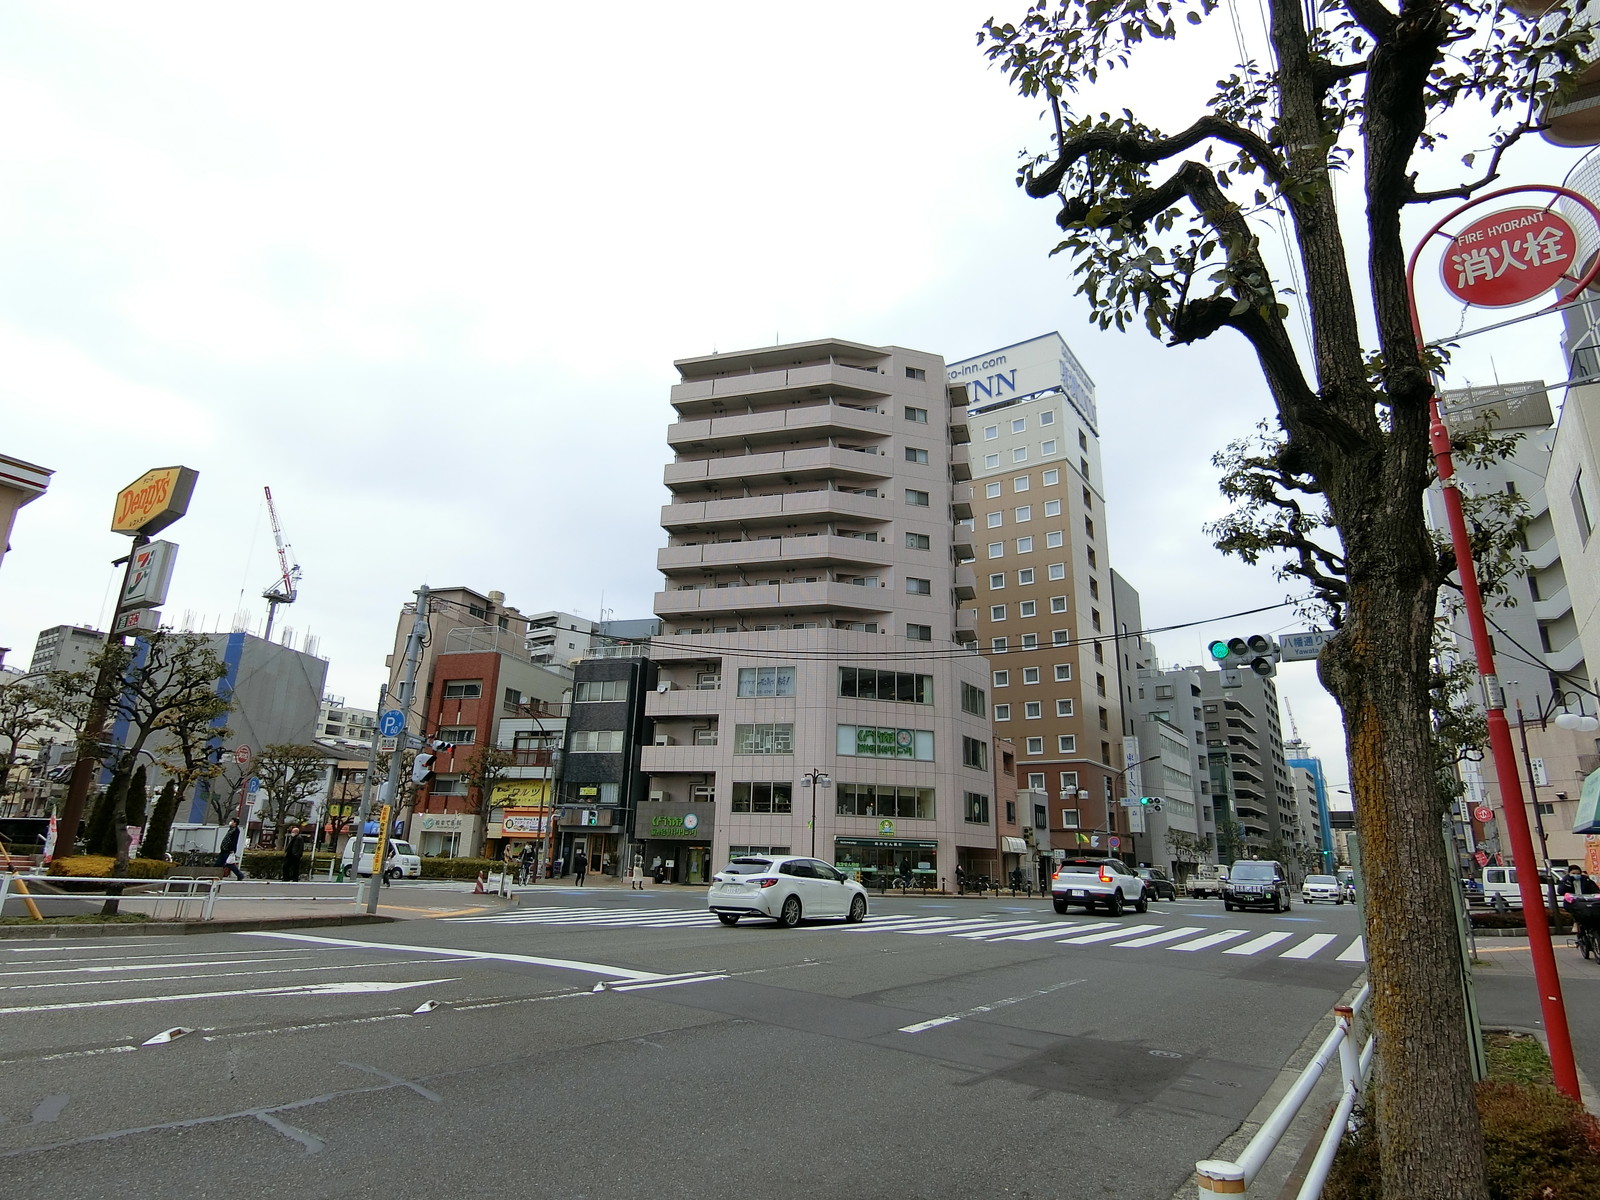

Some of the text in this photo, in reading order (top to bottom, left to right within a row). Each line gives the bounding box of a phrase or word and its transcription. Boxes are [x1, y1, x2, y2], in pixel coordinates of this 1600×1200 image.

[1458, 212, 1545, 247] FIRE HYDRANT
[1451, 226, 1568, 289] 消火栓
[117, 471, 170, 524] Denny's
[384, 716, 396, 734] P
[390, 725, 399, 734] 60
